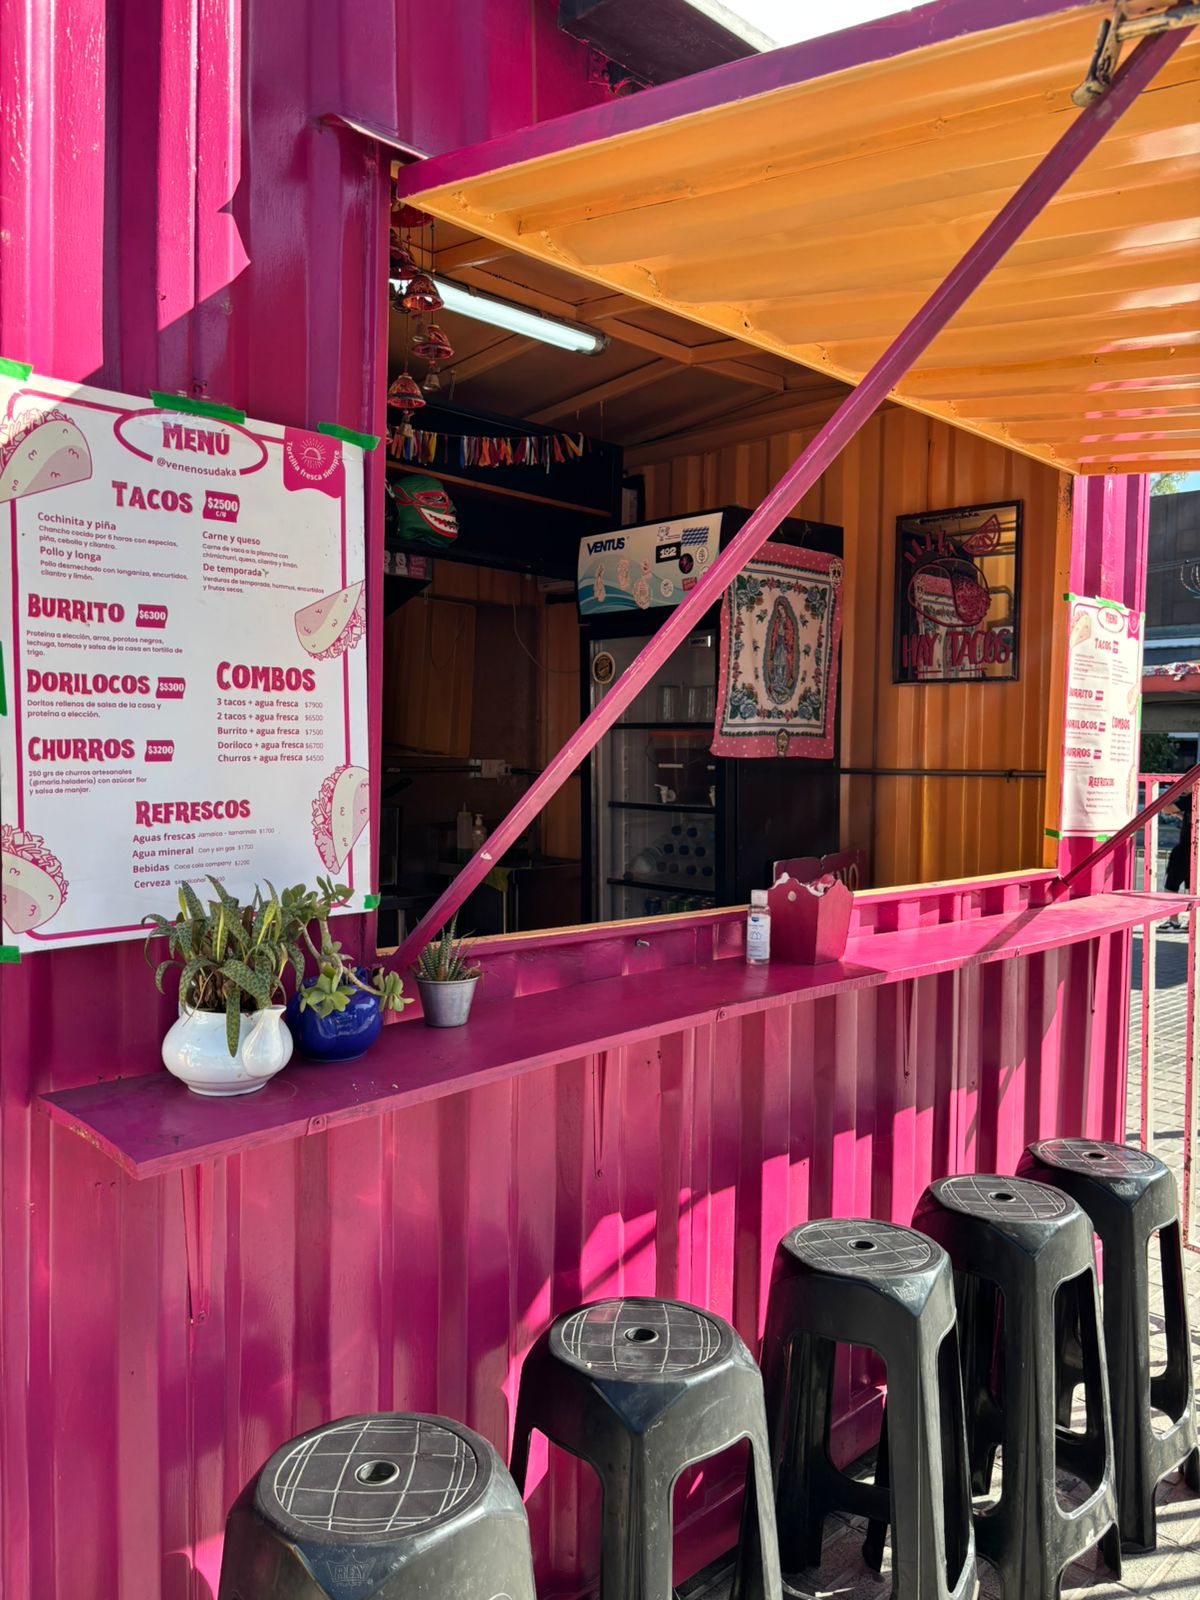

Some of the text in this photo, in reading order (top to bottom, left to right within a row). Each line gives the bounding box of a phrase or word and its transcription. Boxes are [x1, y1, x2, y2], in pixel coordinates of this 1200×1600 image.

[162, 421, 230, 456] MENÚ
[156, 457, 237, 476] @venenosudaka
[286, 441, 340, 480] Tortilla fresca siempre
[112, 480, 238, 513] TACOS $2500
[37, 512, 116, 531] Cochinita y piña
[38, 525, 70, 535] Chancho
[71, 530, 94, 538] cocido
[113, 534, 133, 542] horas
[57, 537, 82, 545] cebolla
[202, 530, 260, 545] Carne y queso
[40, 546, 101, 562] Pollo y longa
[586, 537, 626, 556] VENTUS
[41, 569, 67, 577] cilantro
[57, 562, 102, 572] desmechado
[203, 563, 262, 577] De temporada
[28, 593, 166, 623] BURRITO $6300
[902, 628, 1011, 668] HAY TACOS
[27, 669, 185, 695] DORILOCOS $5300
[216, 661, 315, 692] COMBOS
[217, 698, 222, 706] 3
[224, 698, 246, 706] tacos
[254, 699, 274, 708] agua
[276, 699, 298, 707] fresca
[217, 712, 222, 720] 2
[255, 714, 274, 722] agua
[276, 712, 298, 720] fresca
[217, 726, 247, 735] Burrito
[256, 728, 275, 737] agua
[277, 726, 299, 735] fresca
[28, 736, 174, 762] CHURROS $3200
[217, 741, 252, 749] Doriloco
[260, 742, 280, 751] agua
[281, 740, 304, 748] fresca
[217, 754, 251, 762] Churros
[259, 755, 278, 764] agua
[280, 753, 303, 761] fresca
[135, 799, 251, 828] REFRESCOS
[133, 834, 161, 844] Aguas
[163, 832, 196, 841] frescas
[132, 849, 158, 859] Agua
[158, 846, 194, 856] mineral
[132, 864, 169, 874] Bebidas
[134, 879, 171, 889] Cerveza
